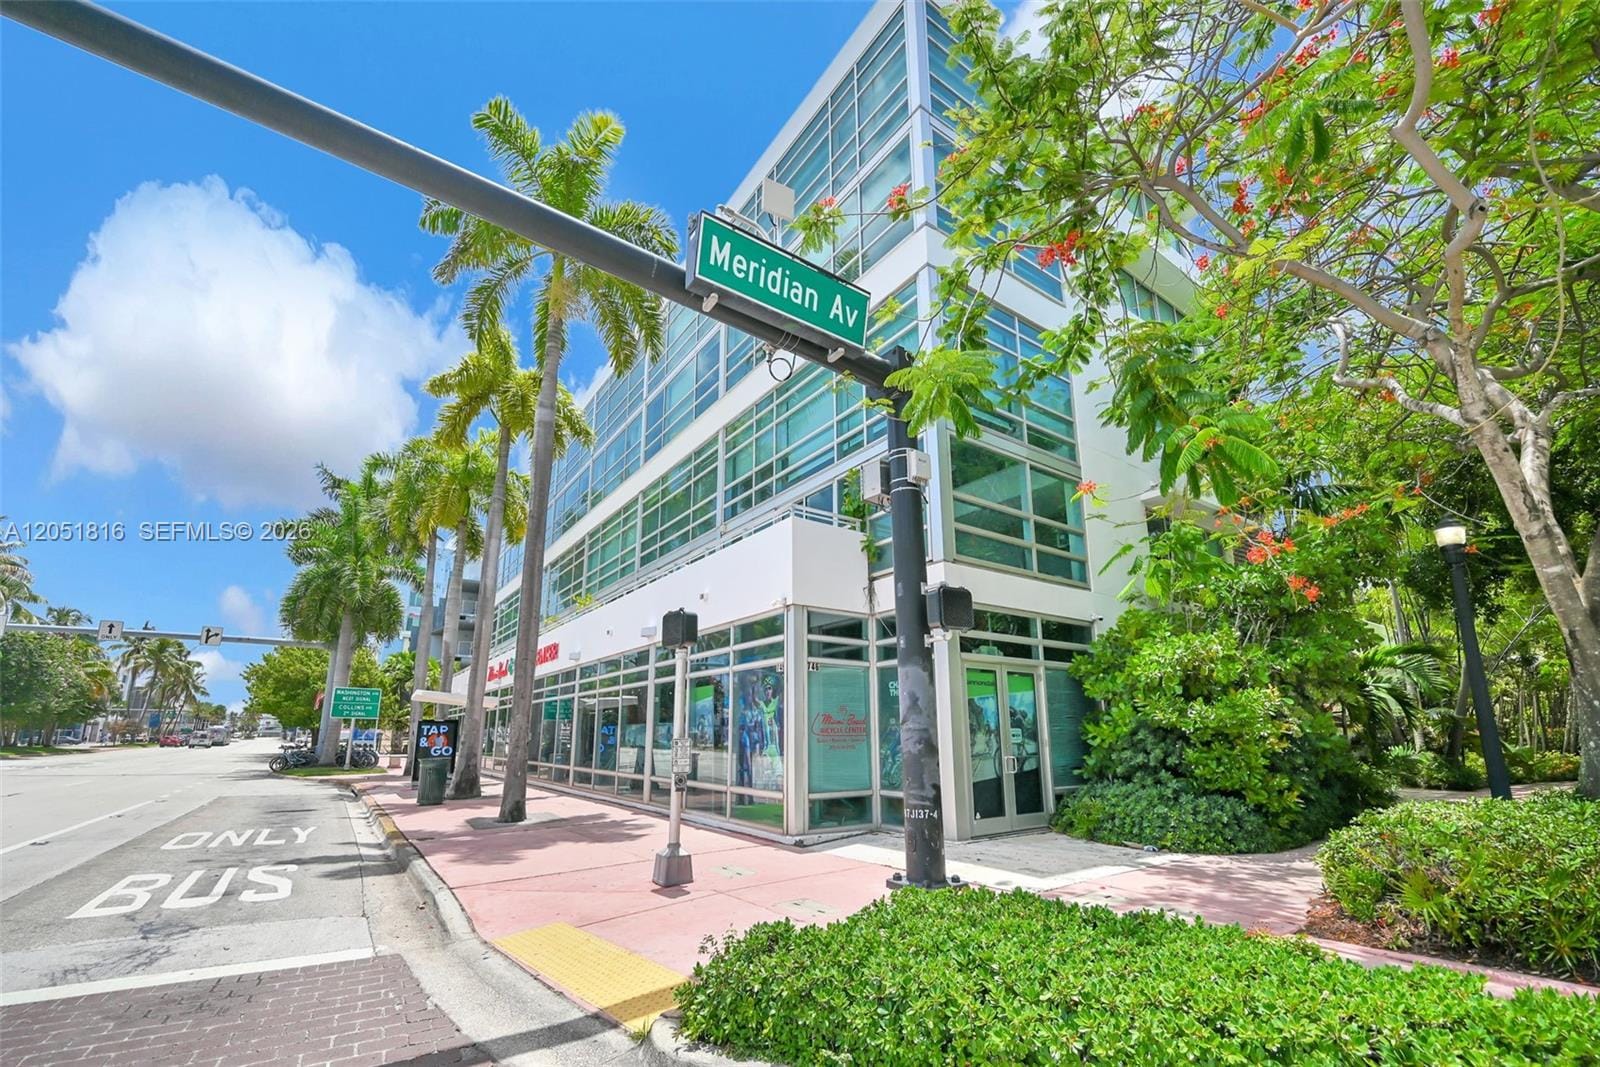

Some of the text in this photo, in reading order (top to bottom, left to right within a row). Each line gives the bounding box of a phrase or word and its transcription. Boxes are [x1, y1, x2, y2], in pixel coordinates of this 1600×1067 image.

[709, 235, 859, 328] Meridian Av
[421, 725, 449, 735] TAP
[419, 736, 429, 747] &
[430, 745, 453, 757] GO
[160, 826, 318, 850] ONLY
[65, 864, 299, 920] BUS
